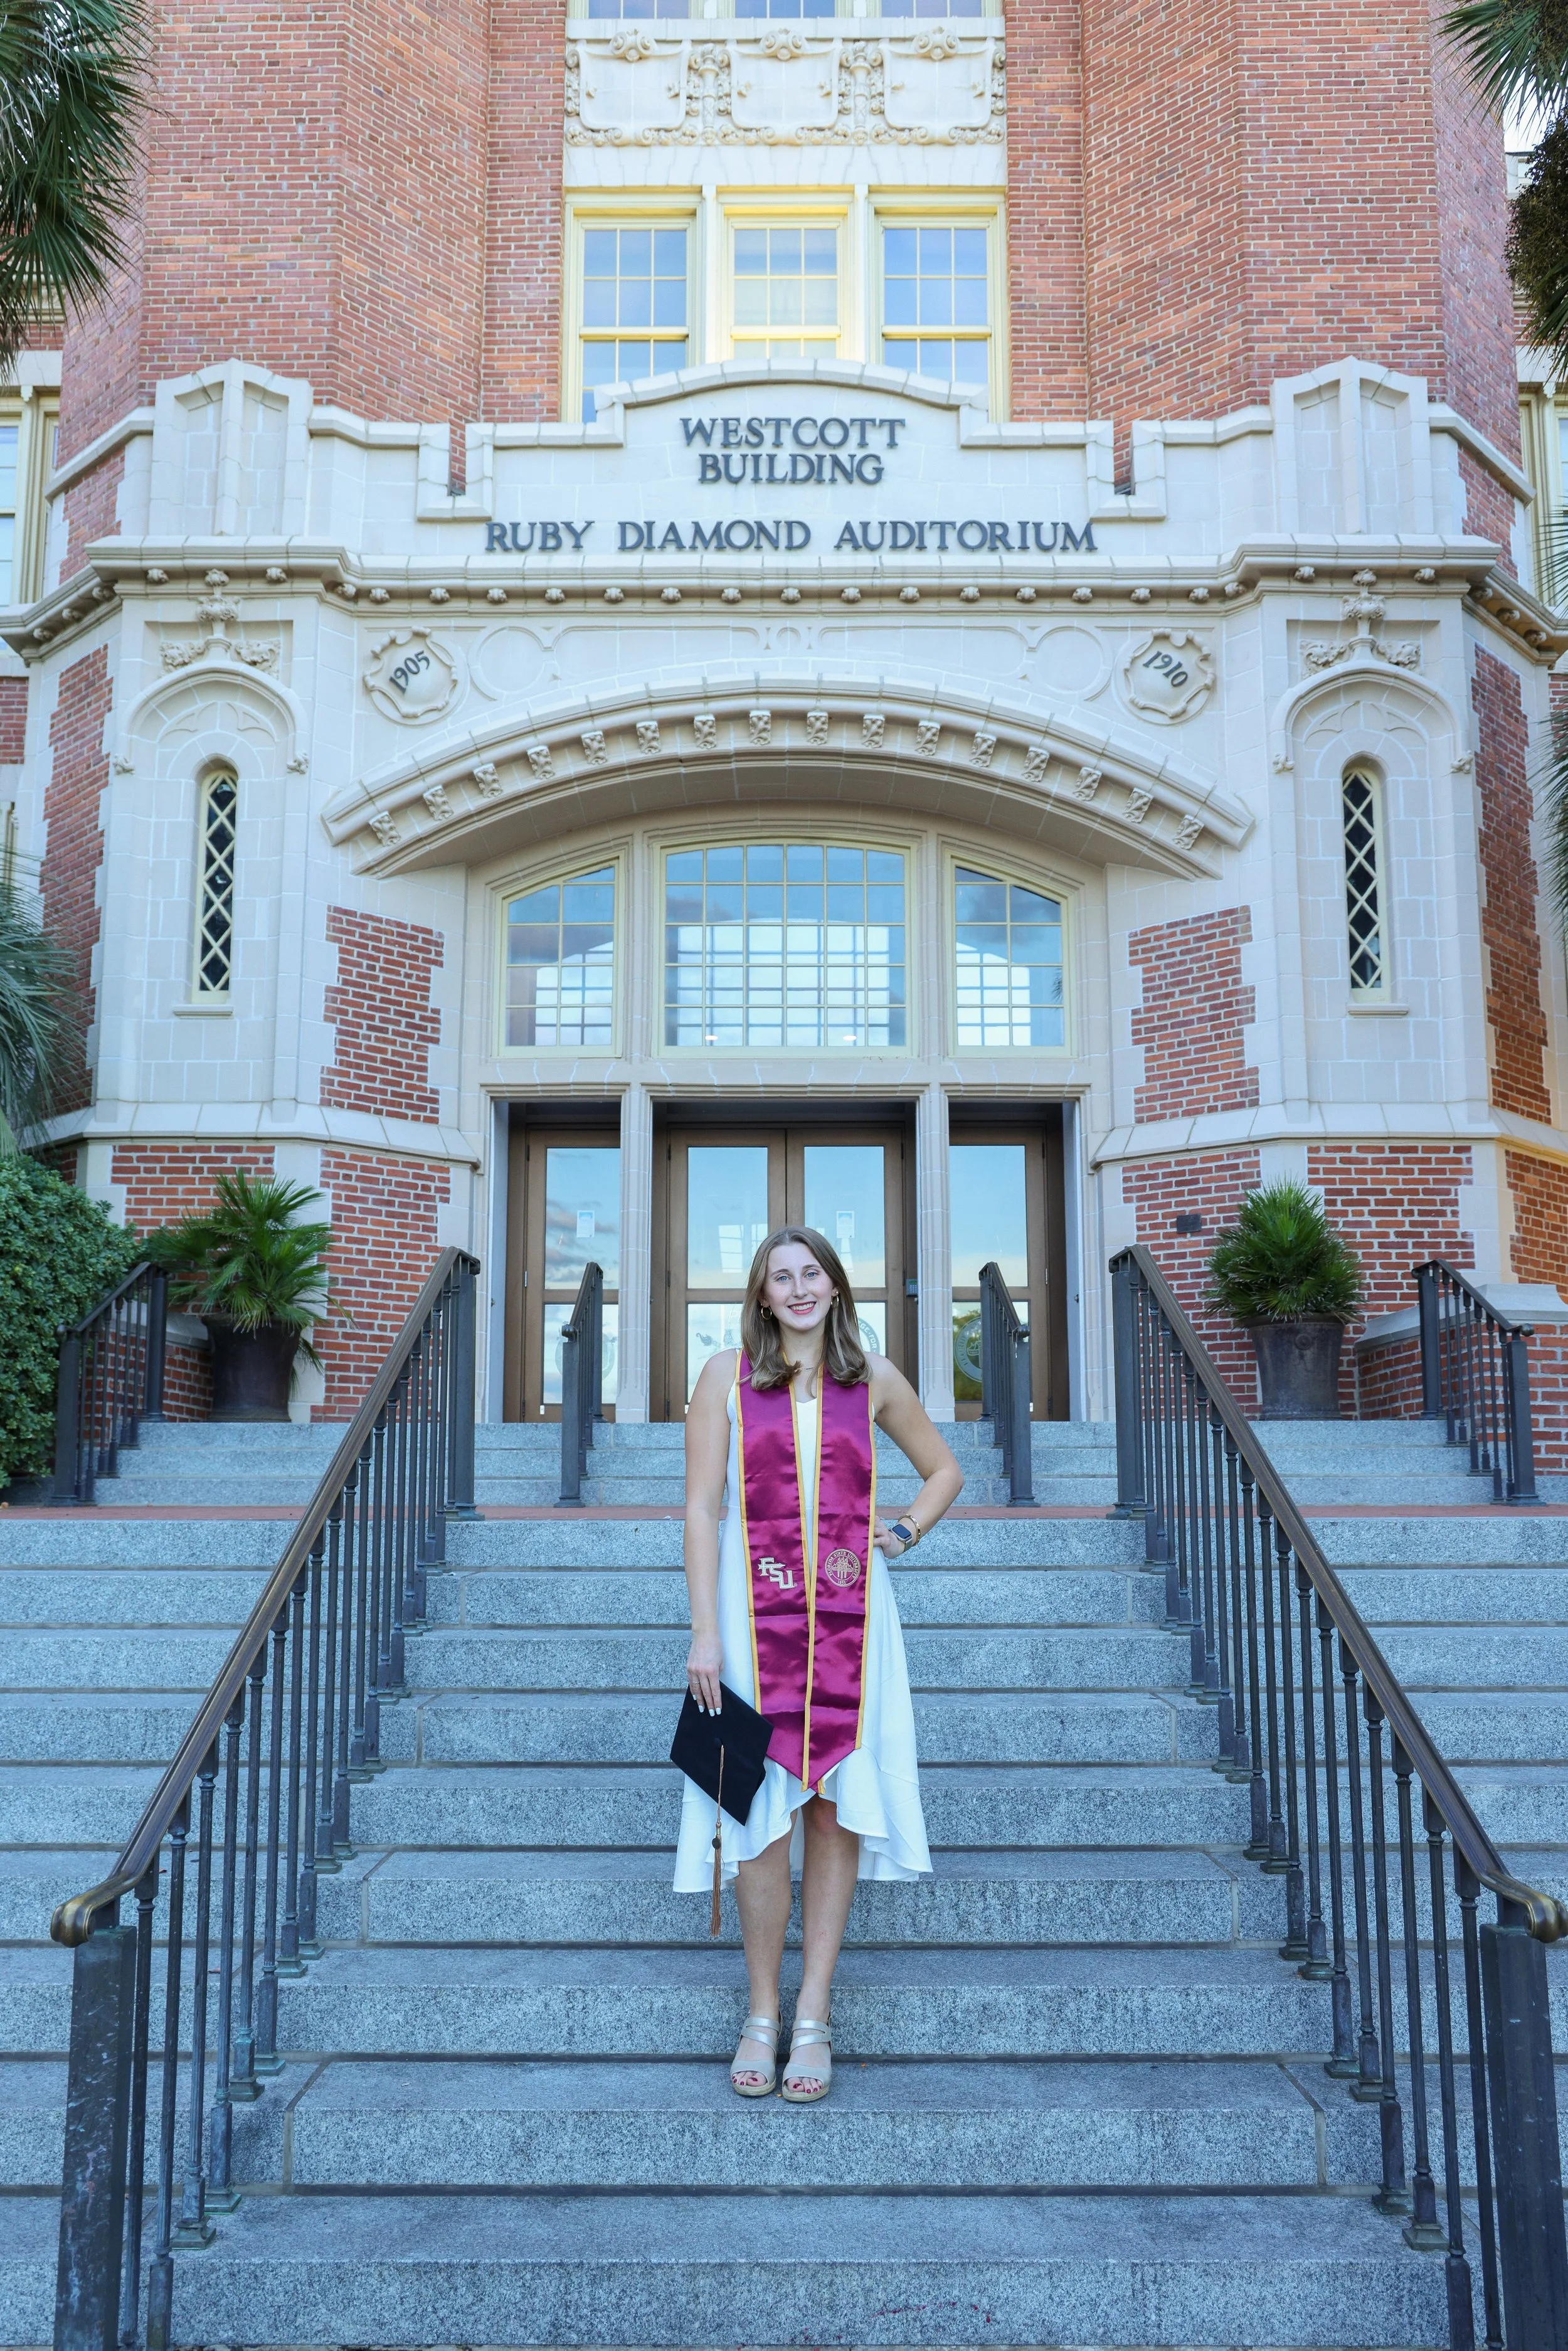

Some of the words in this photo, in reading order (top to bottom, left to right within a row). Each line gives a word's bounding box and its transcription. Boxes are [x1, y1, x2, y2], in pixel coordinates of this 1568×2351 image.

[680, 417, 905, 449] WESTCOTT
[699, 454, 884, 485] BUILDING
[485, 521, 595, 552] RUBY
[618, 520, 811, 551] DIAMOND
[834, 521, 1098, 552] AUDITORIUM
[389, 650, 430, 694] 1905
[1143, 650, 1189, 687] 1910
[758, 1557, 795, 1589] FSU
[847, 1552, 858, 1579] UNIVERSITY
